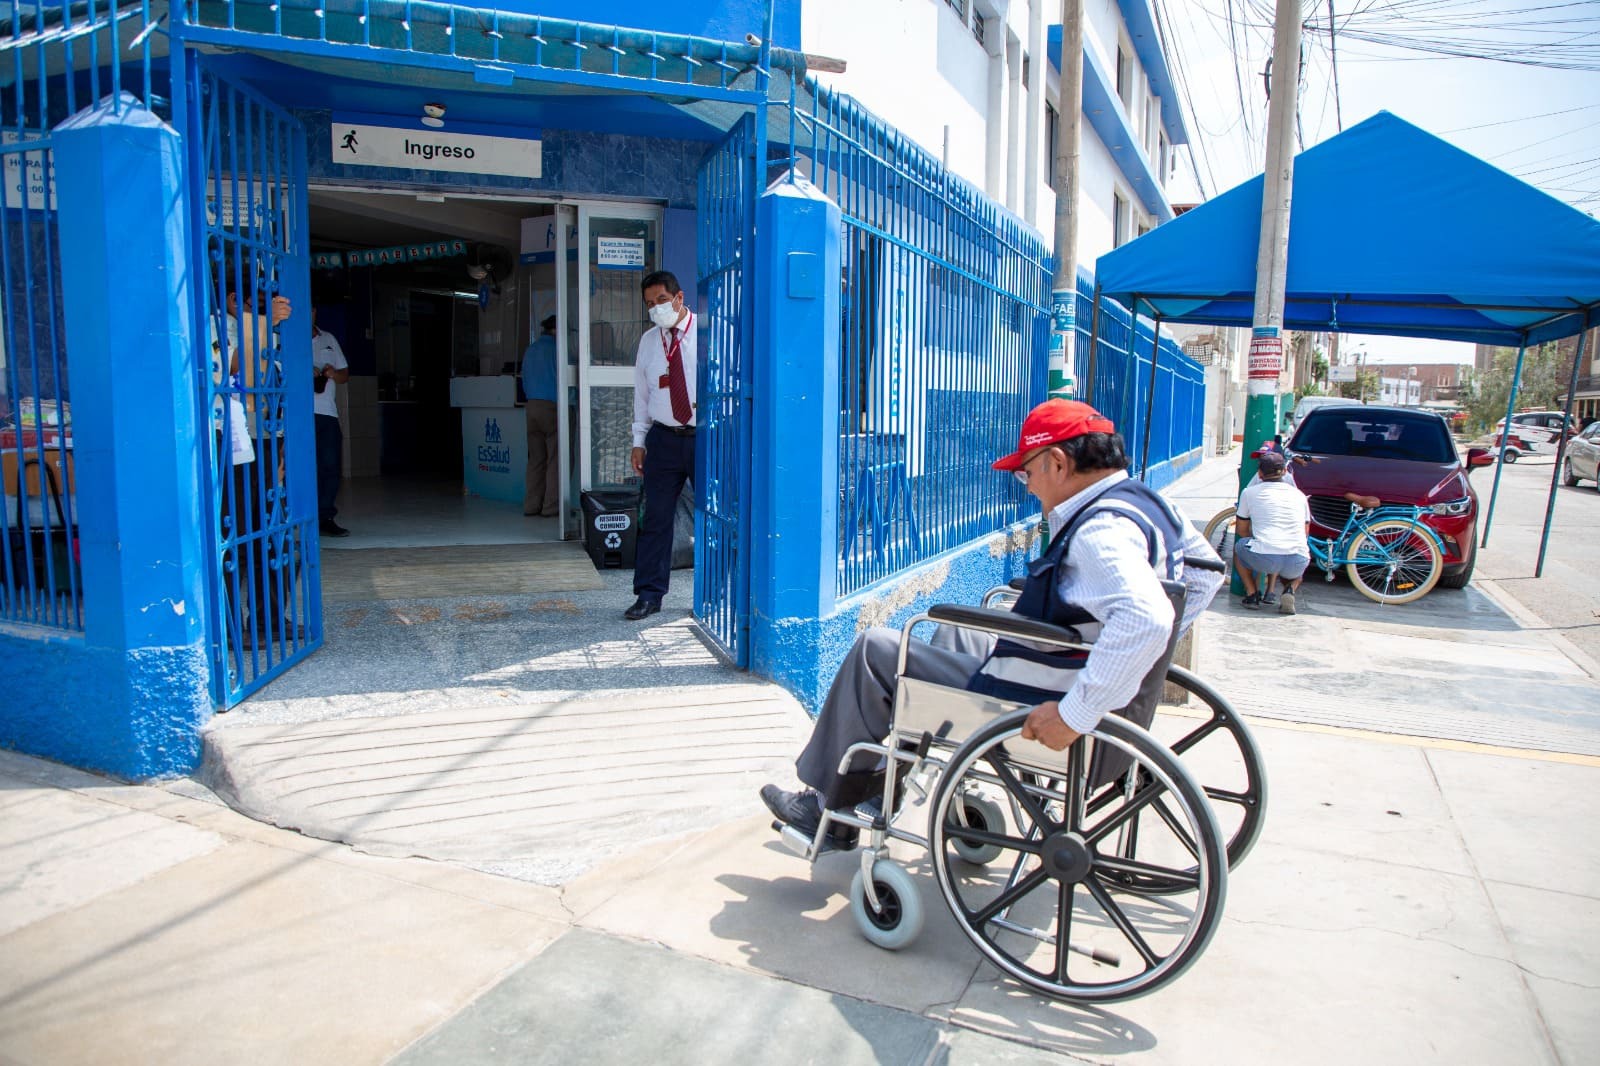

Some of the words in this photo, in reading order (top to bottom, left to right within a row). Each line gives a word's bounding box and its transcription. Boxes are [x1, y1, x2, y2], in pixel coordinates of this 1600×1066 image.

[405, 139, 475, 159] Ingreso
[351, 242, 461, 263] DIABETES
[478, 445, 510, 464] EsSalud
[599, 515, 626, 523] RESIDUOS
